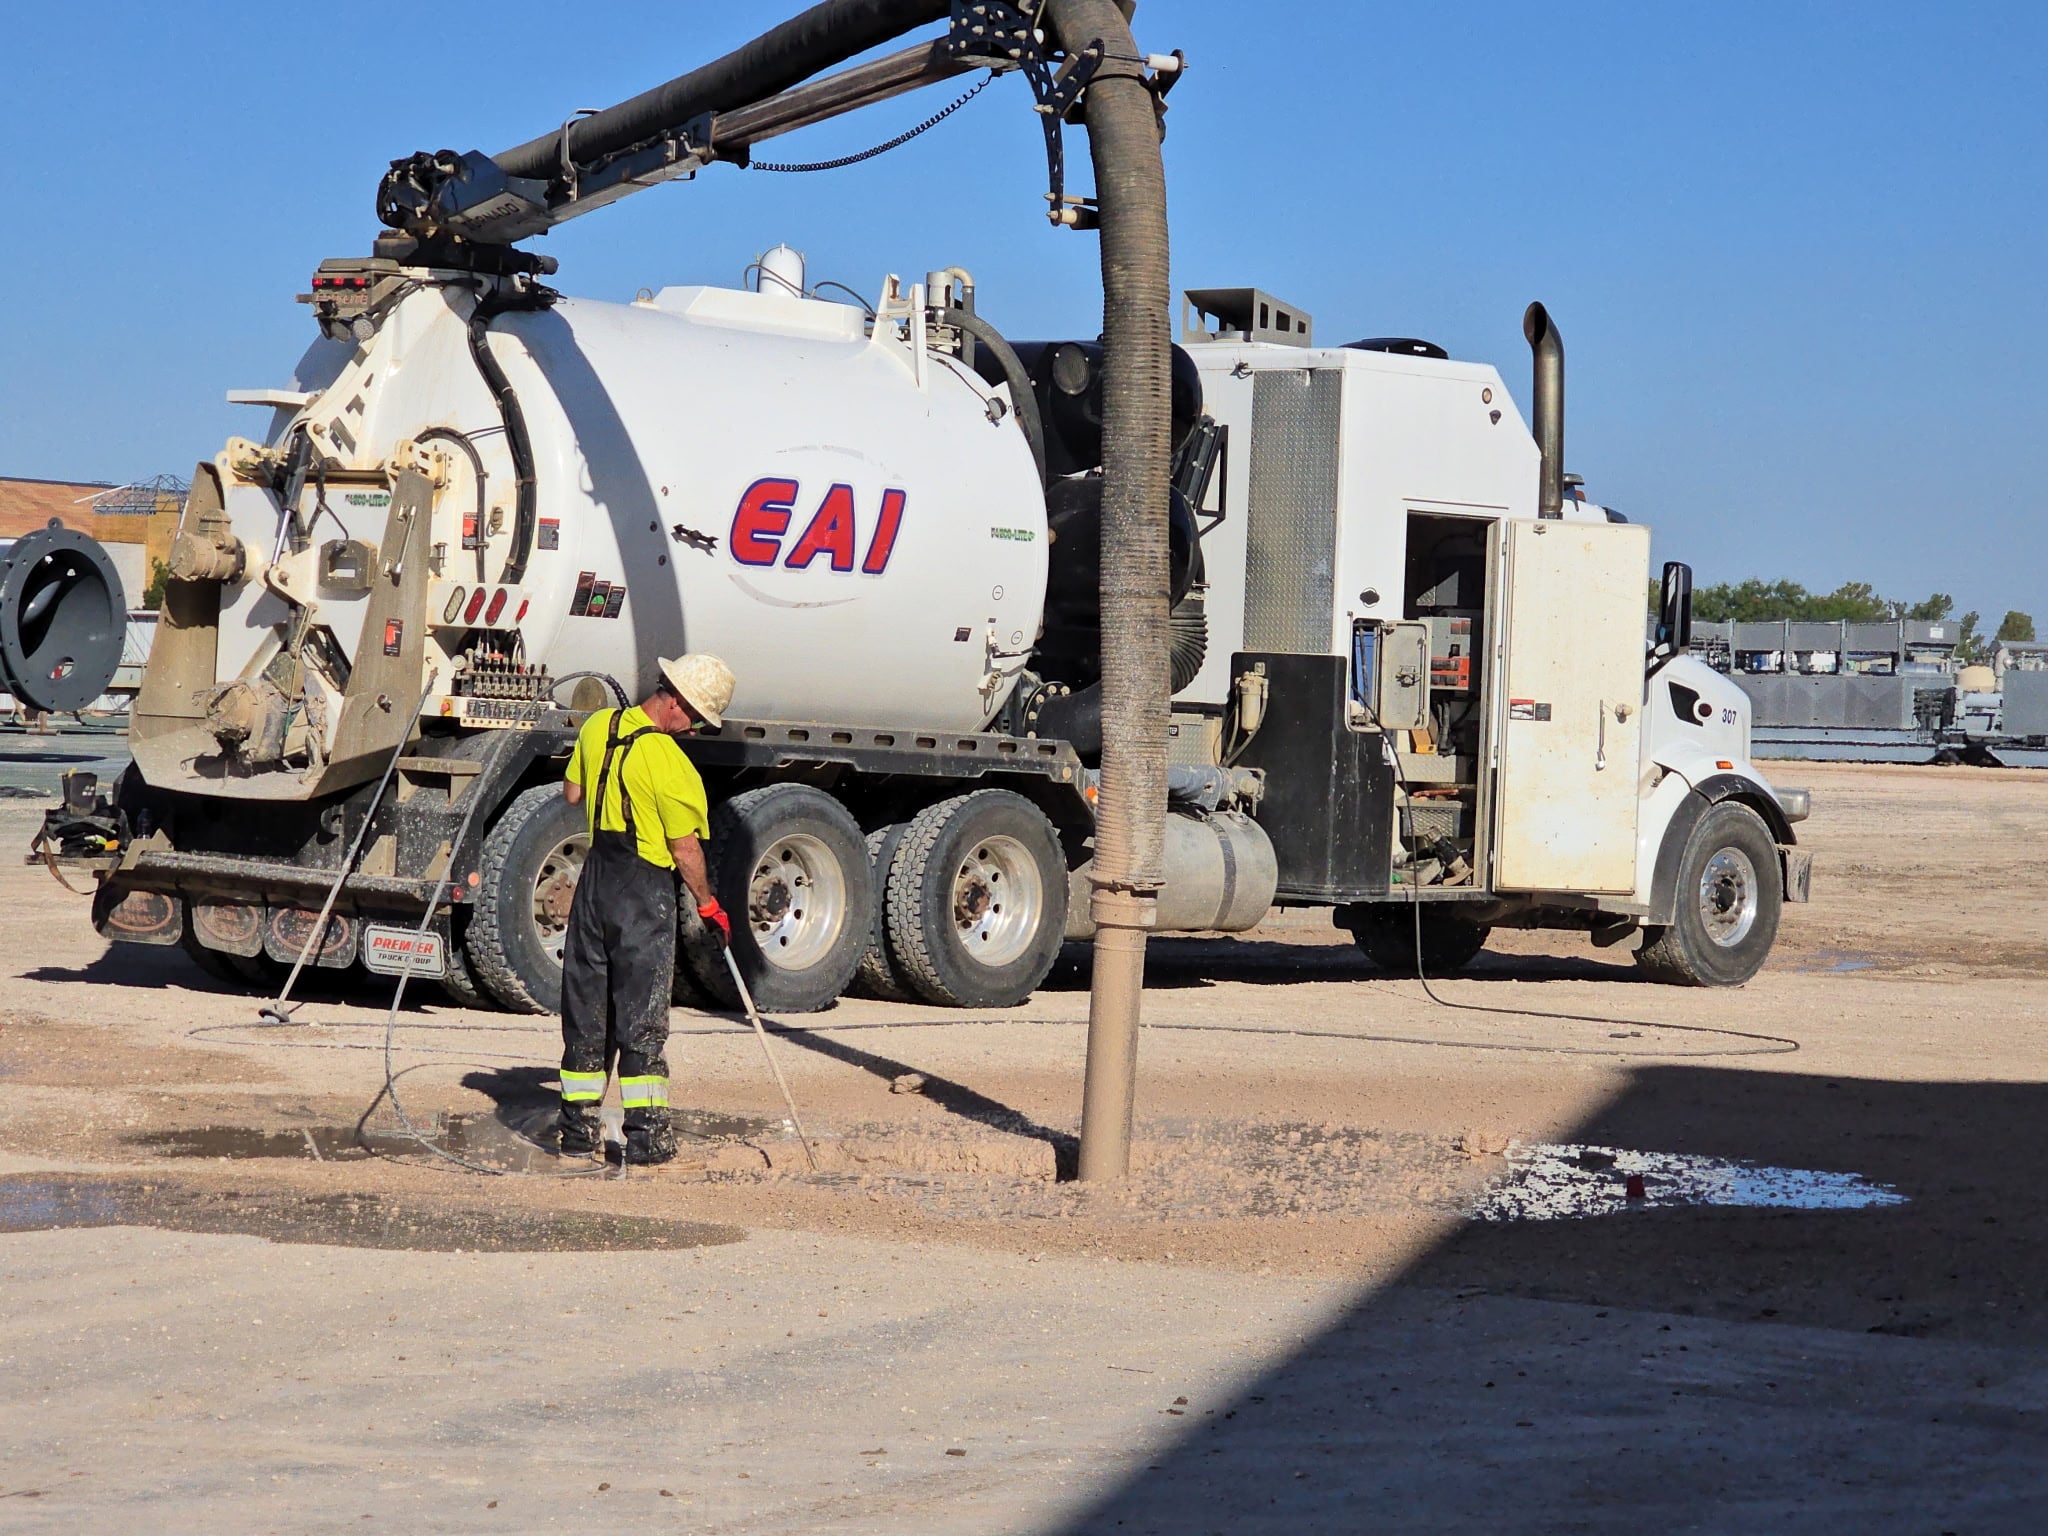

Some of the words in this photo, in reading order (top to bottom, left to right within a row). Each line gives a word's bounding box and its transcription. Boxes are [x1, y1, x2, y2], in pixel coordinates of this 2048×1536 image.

[730, 477, 907, 575] EAI
[1722, 708, 1737, 726] 307
[372, 937, 434, 954] PREMER
[377, 952, 403, 963] TRUCK
[405, 956, 432, 966] GOUP
